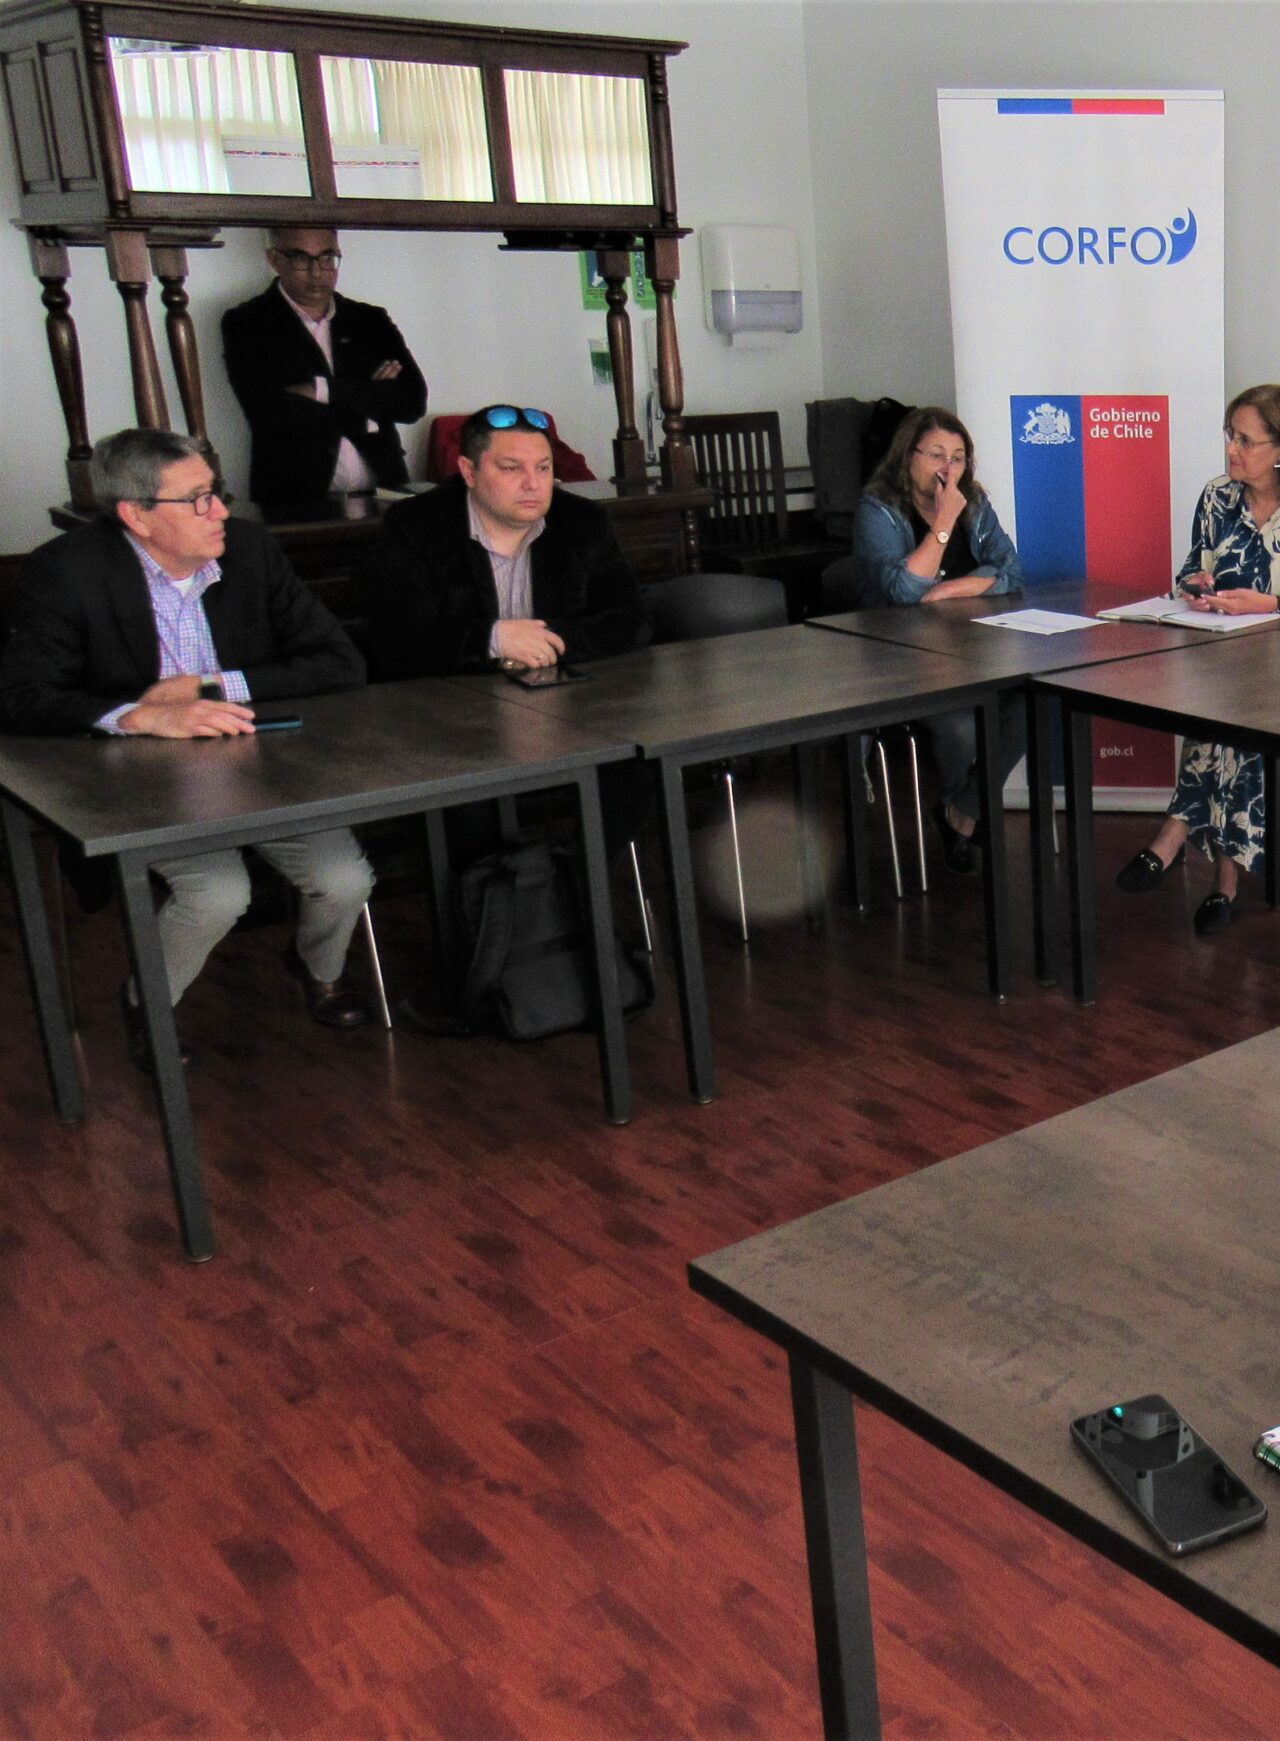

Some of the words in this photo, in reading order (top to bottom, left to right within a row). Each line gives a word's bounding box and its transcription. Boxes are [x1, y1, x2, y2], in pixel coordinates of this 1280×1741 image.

[1002, 225, 1168, 266] CORFO
[1089, 407, 1161, 422] Gobierno
[1090, 424, 1109, 438] de
[1113, 424, 1153, 438] Chile
[1100, 745, 1134, 759] gob.cl
